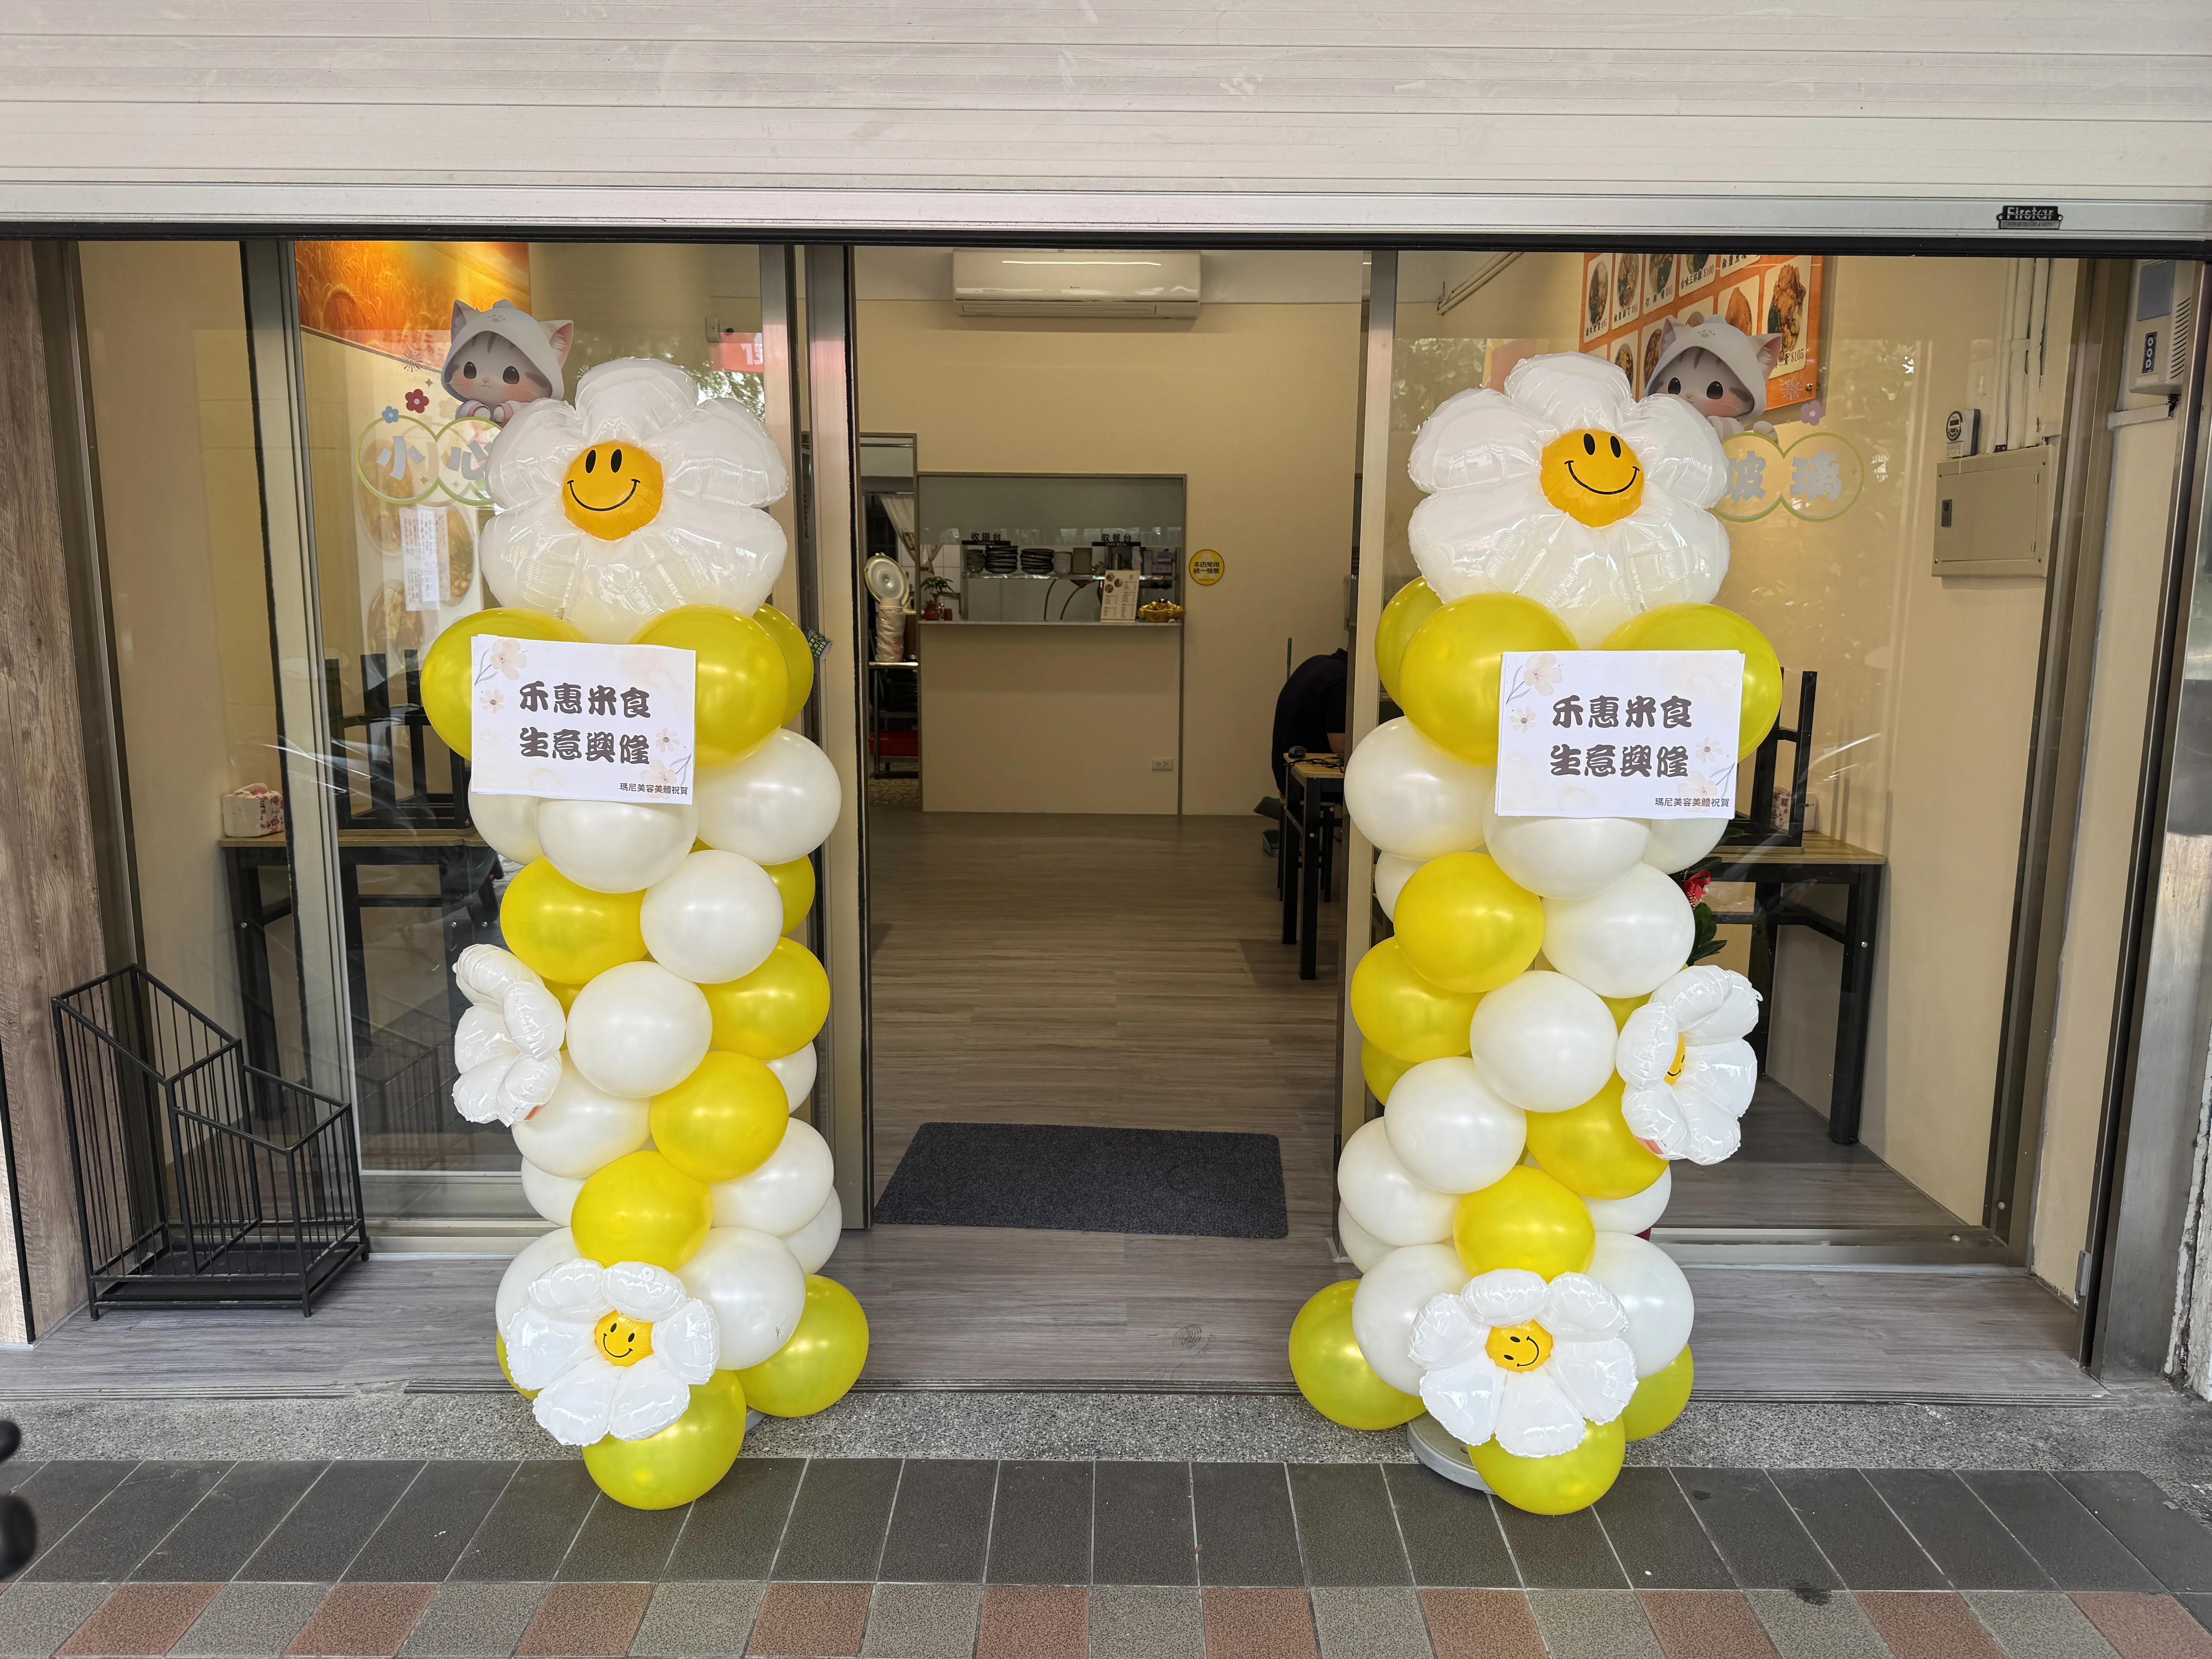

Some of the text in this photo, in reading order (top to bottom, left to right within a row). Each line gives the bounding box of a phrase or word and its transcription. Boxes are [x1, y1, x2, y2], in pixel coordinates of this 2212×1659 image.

[2006, 207, 2054, 220] Firstar
[1703, 264, 1714, 277] $100
[1790, 349, 1804, 363] $105
[1726, 450, 1843, 502] 玻璃
[971, 532, 1001, 541] 收銀台
[1101, 533, 1132, 542] 取餐台
[519, 726, 650, 765] 生意興隆
[1550, 744, 1688, 778] 生意興隆
[620, 783, 688, 795] 瑪尼美容美體祝賀
[1655, 797, 1729, 807] 瑪尼美容美體祝賀
